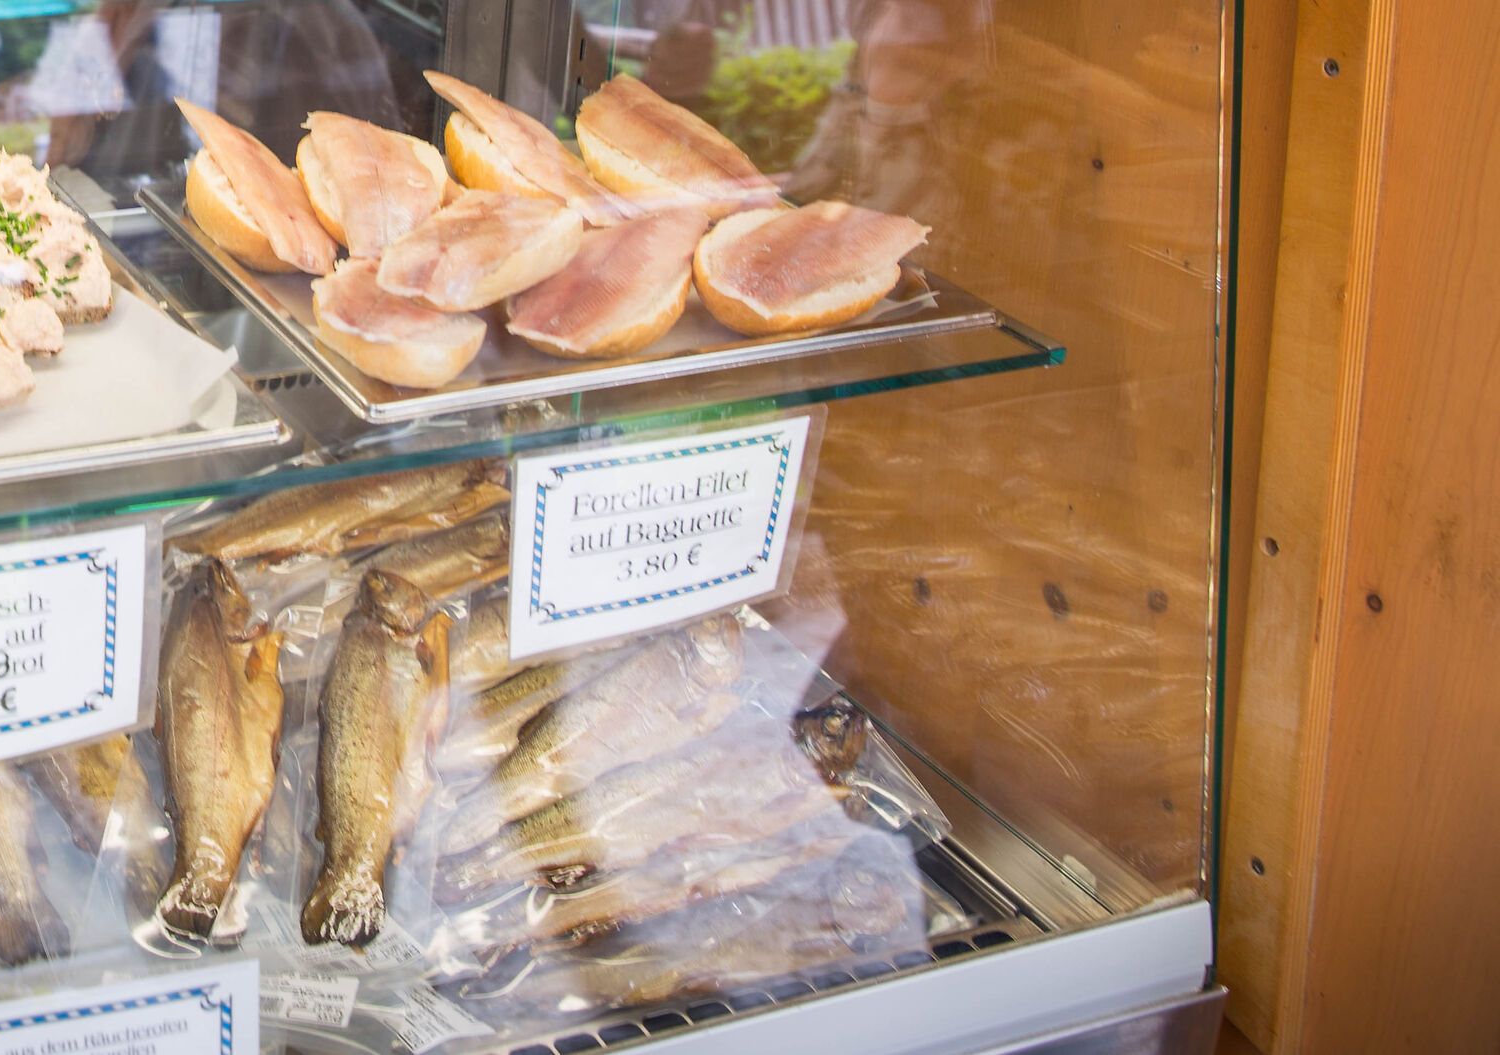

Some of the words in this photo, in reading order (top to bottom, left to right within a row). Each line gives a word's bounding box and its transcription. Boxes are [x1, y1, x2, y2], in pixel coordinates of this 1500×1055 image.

[574, 470, 748, 517] Forellen-Filet
[570, 525, 617, 555] auf
[625, 506, 743, 544] Baguette
[617, 552, 678, 582] 3.80
[688, 544, 702, 567] €
[5, 622, 44, 647] auf
[0, 688, 17, 714] €
[40, 1035, 80, 1055] dem
[84, 1018, 188, 1051] Räucherofen
